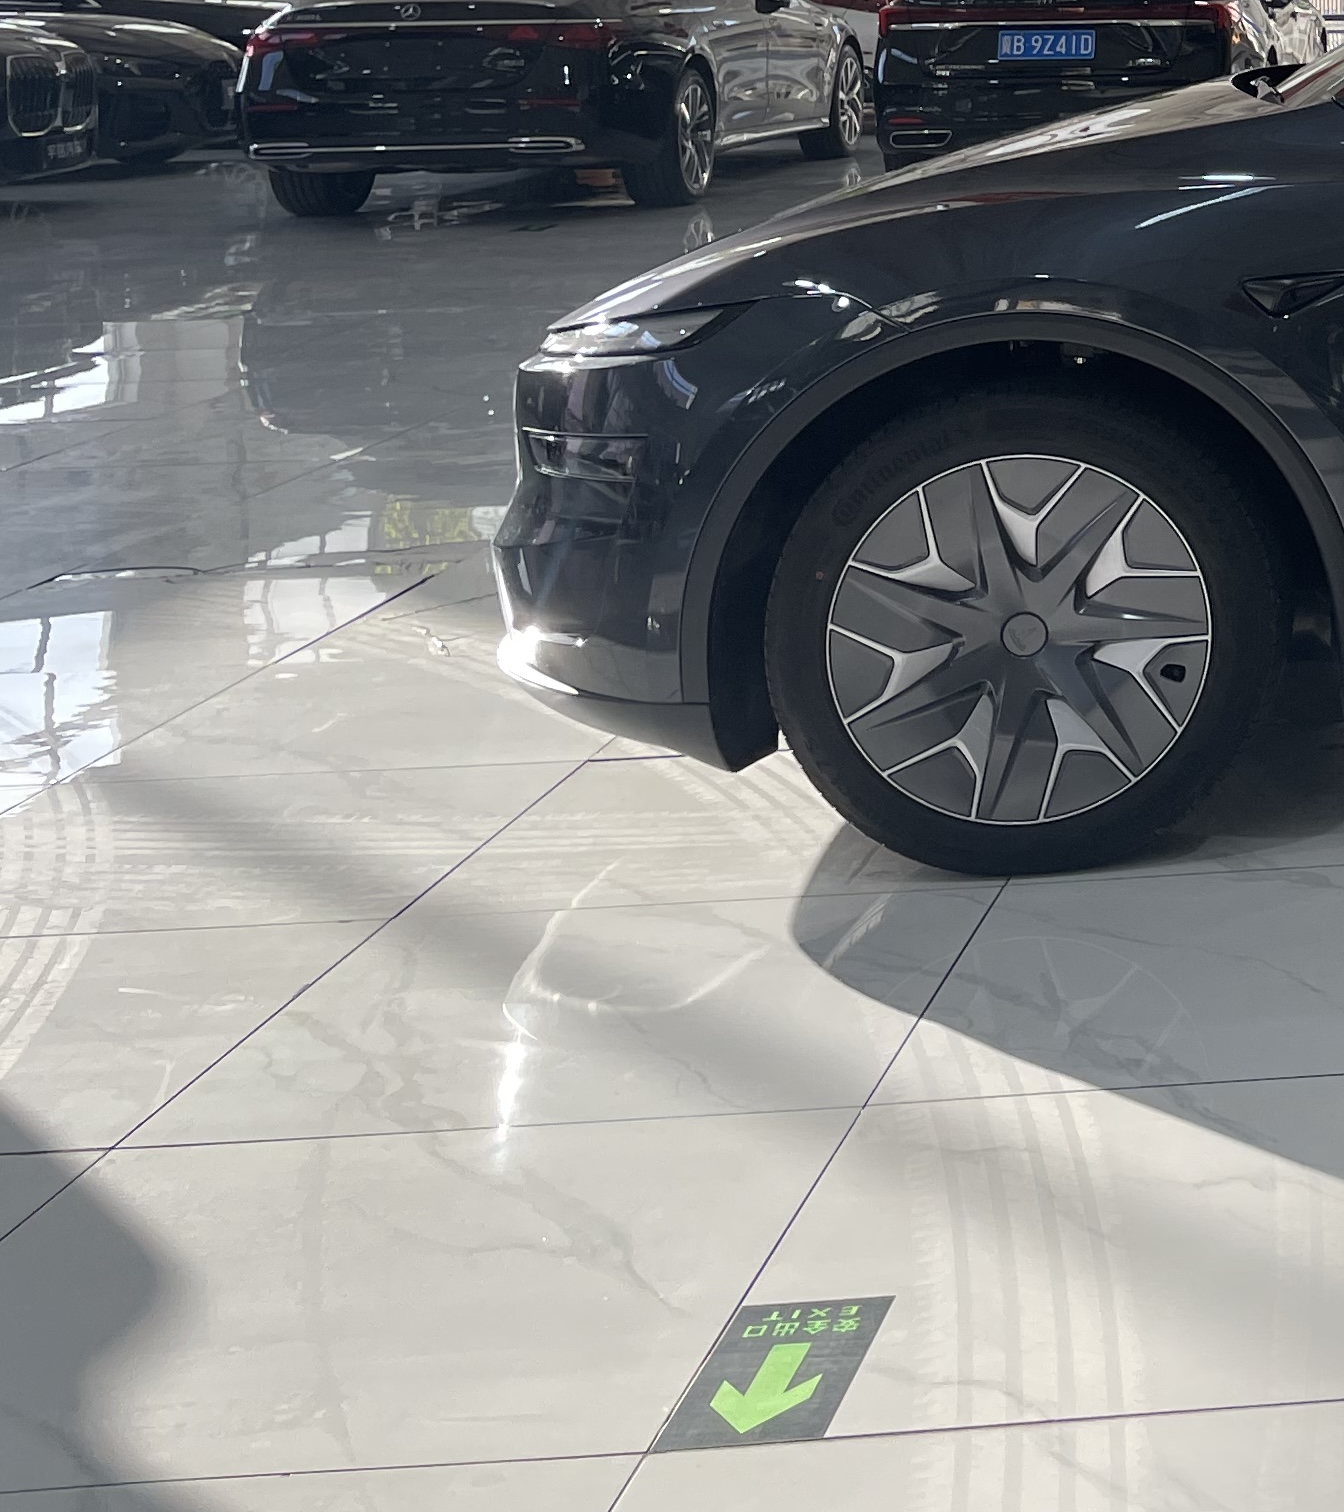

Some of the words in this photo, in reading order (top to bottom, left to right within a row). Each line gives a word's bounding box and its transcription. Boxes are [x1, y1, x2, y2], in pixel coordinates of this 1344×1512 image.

[762, 1305, 862, 1321] EXIT
[742, 1317, 861, 1338] 安全出口
